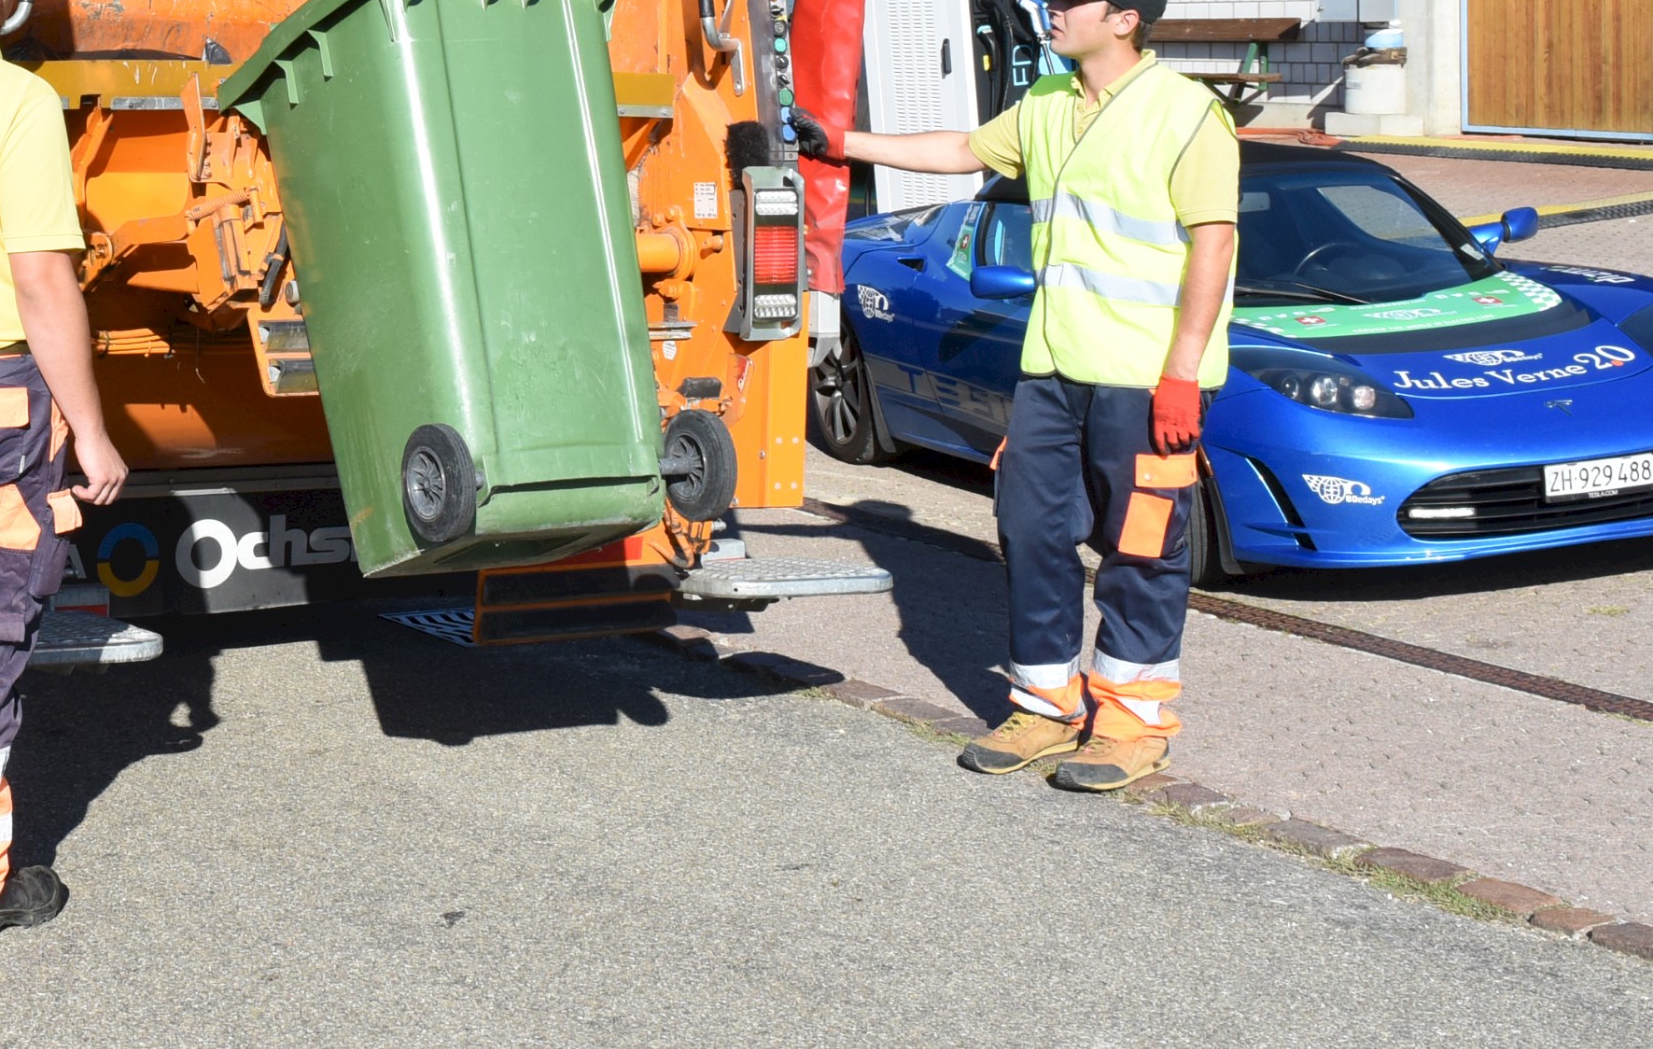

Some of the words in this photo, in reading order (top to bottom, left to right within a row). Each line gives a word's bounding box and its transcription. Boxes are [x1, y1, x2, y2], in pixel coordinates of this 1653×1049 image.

[1394, 370, 1490, 390] Jules
[1484, 362, 1587, 385] Verne
[1345, 494, 1383, 506] 80edays
[1588, 489, 1618, 499] TESLA.COM
[175, 513, 357, 590] Ochs
